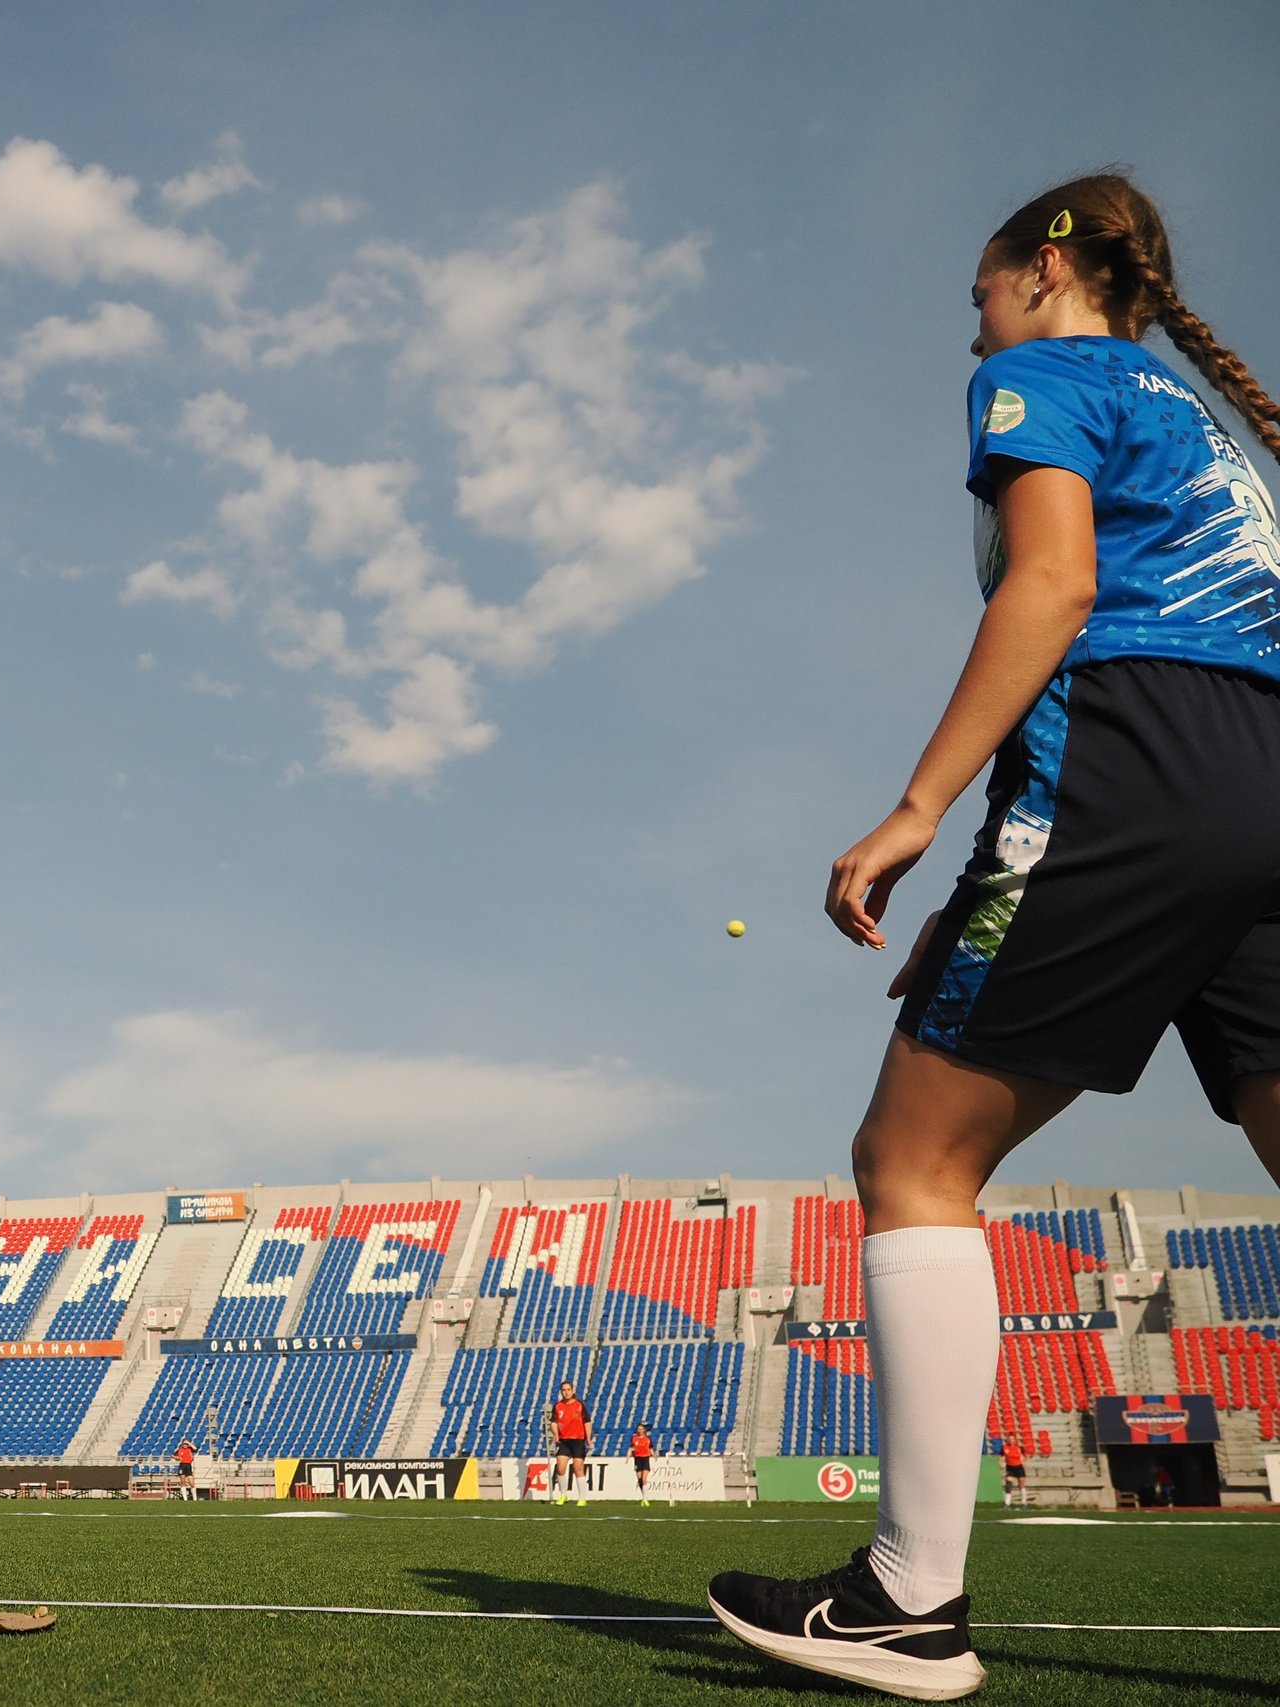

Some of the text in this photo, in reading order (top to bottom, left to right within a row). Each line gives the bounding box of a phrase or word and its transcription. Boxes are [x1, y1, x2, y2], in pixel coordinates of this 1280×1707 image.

[180, 1207, 234, 1218] ИЗ СИБИРИ
[1003, 1313, 1093, 1331] ОВОМУ
[807, 1322, 867, 1337] ФУТ
[211, 1339, 262, 1353] ОДНА
[344, 1462, 444, 1471] рекламная компания
[652, 1467, 683, 1477] УППА
[344, 1473, 445, 1500] ИЛАН
